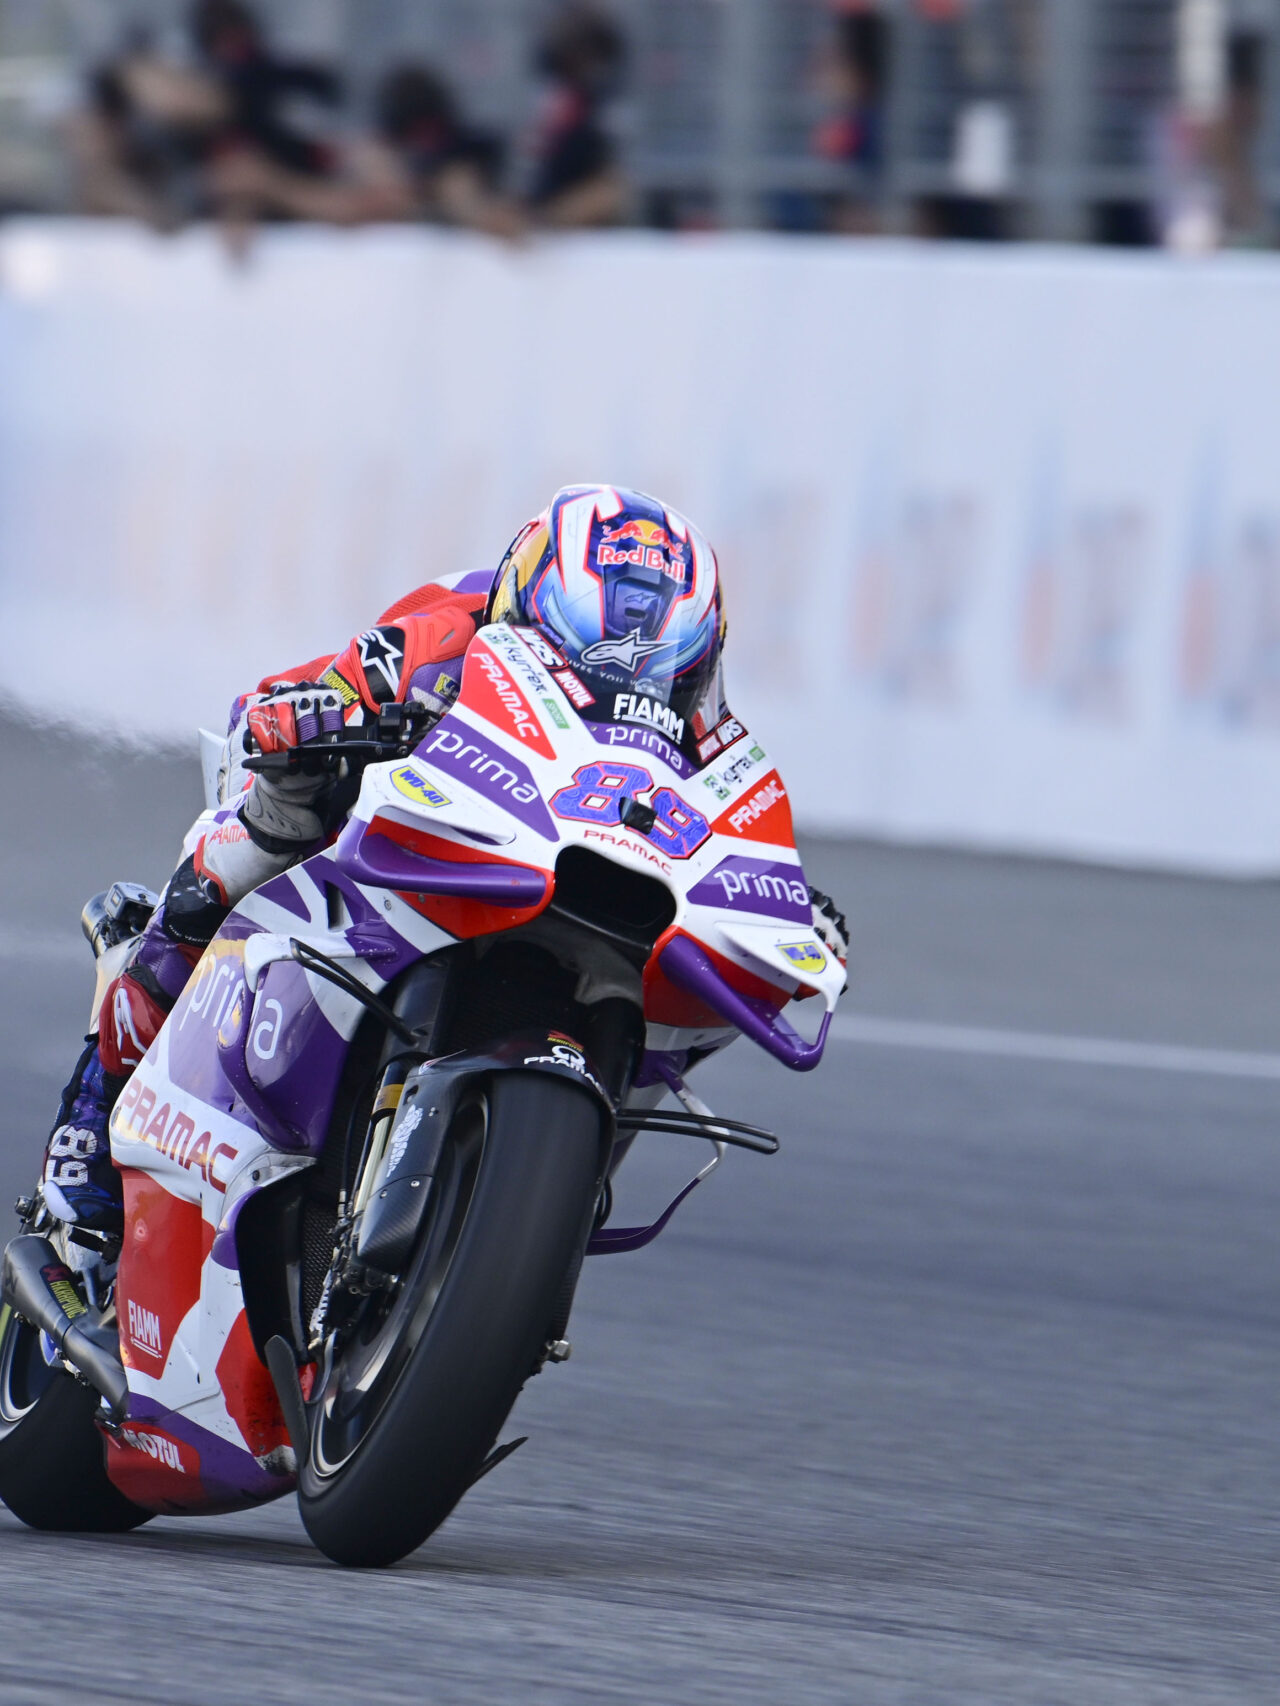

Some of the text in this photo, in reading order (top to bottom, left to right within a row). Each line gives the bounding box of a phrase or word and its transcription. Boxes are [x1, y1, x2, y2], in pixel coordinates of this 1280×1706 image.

[596, 544, 686, 584] Red Bull
[471, 652, 540, 740] PRAMAC
[555, 671, 592, 708] MOTUL
[613, 693, 685, 741] FIAMM
[426, 729, 539, 803] prima
[606, 726, 683, 770] prima
[399, 769, 444, 805] WD-40
[548, 761, 712, 860] 89
[728, 780, 786, 833] PRAMAC
[584, 829, 672, 876] PRAMAC
[713, 868, 810, 906] prima
[120, 1078, 238, 1194] PRAMAC
[127, 1299, 162, 1351] FIAMM
